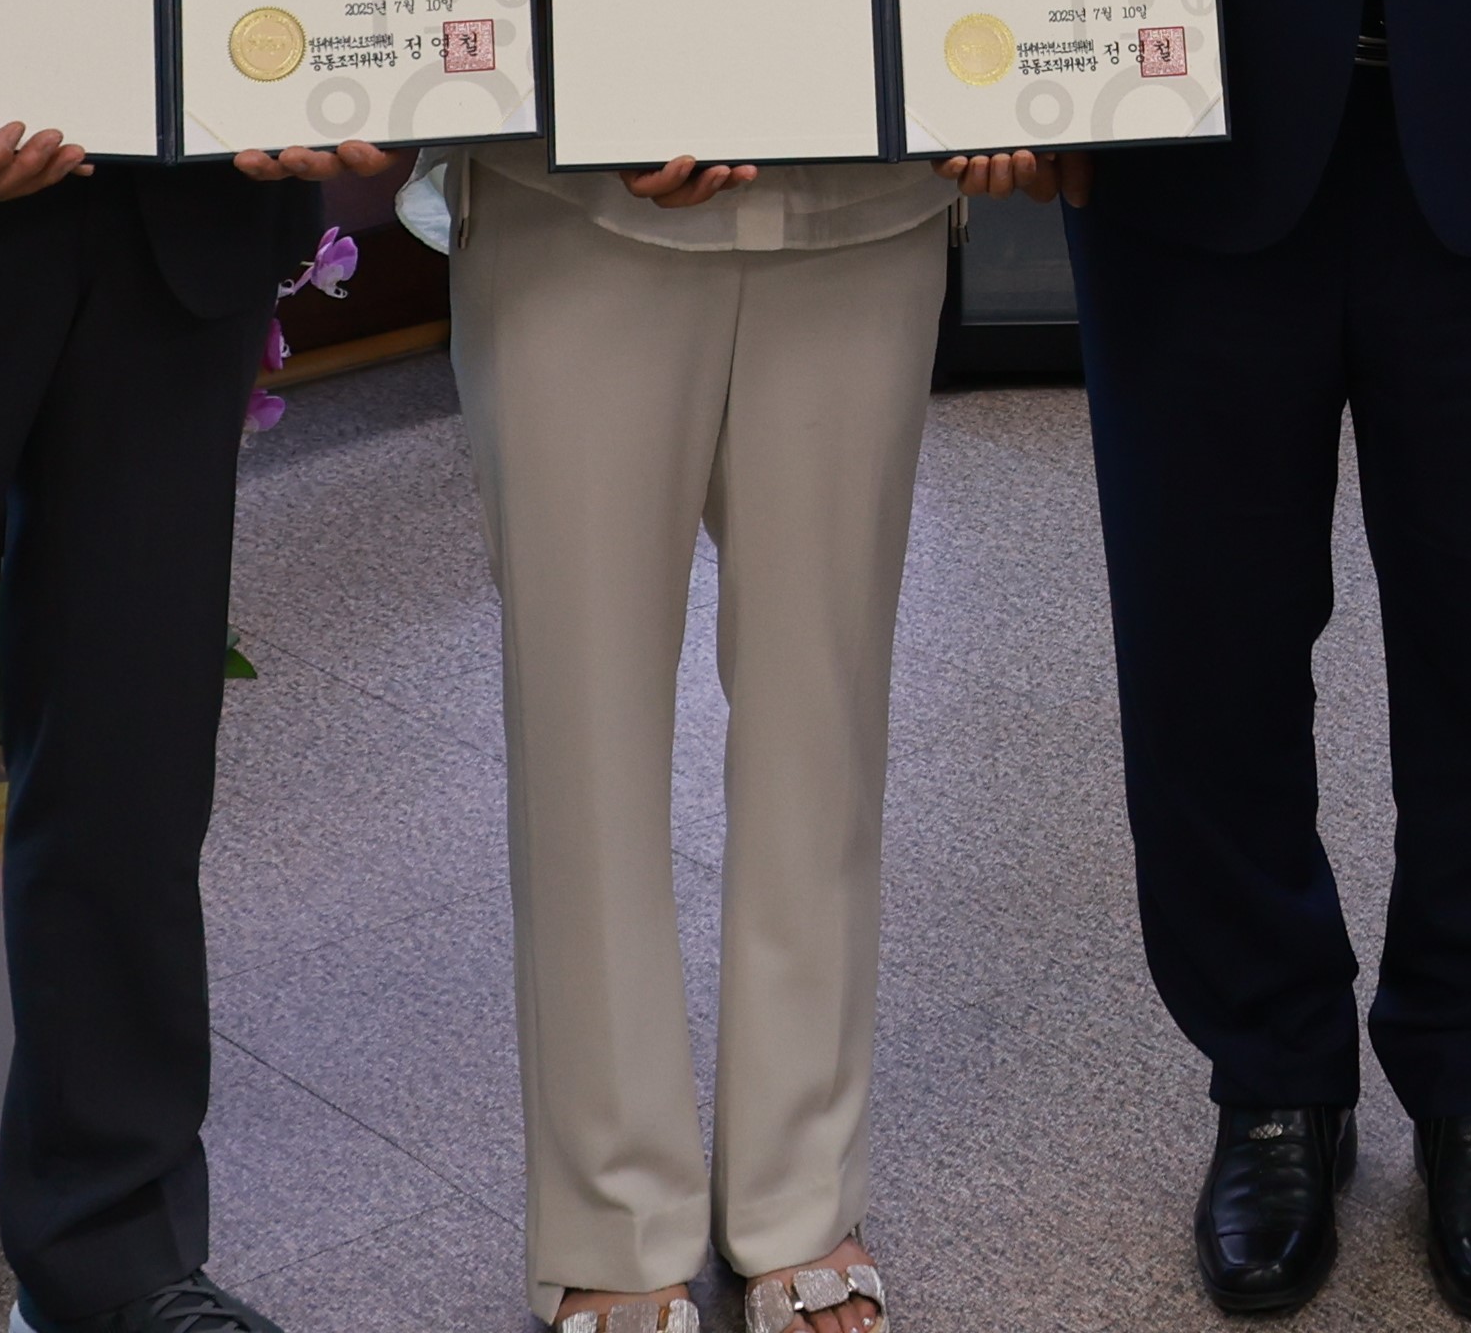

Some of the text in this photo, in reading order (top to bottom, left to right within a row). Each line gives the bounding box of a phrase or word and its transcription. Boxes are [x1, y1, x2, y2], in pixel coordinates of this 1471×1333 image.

[345, 0, 387, 16] 2025년
[309, 31, 478, 72] 공동조직위원장 정 영 철
